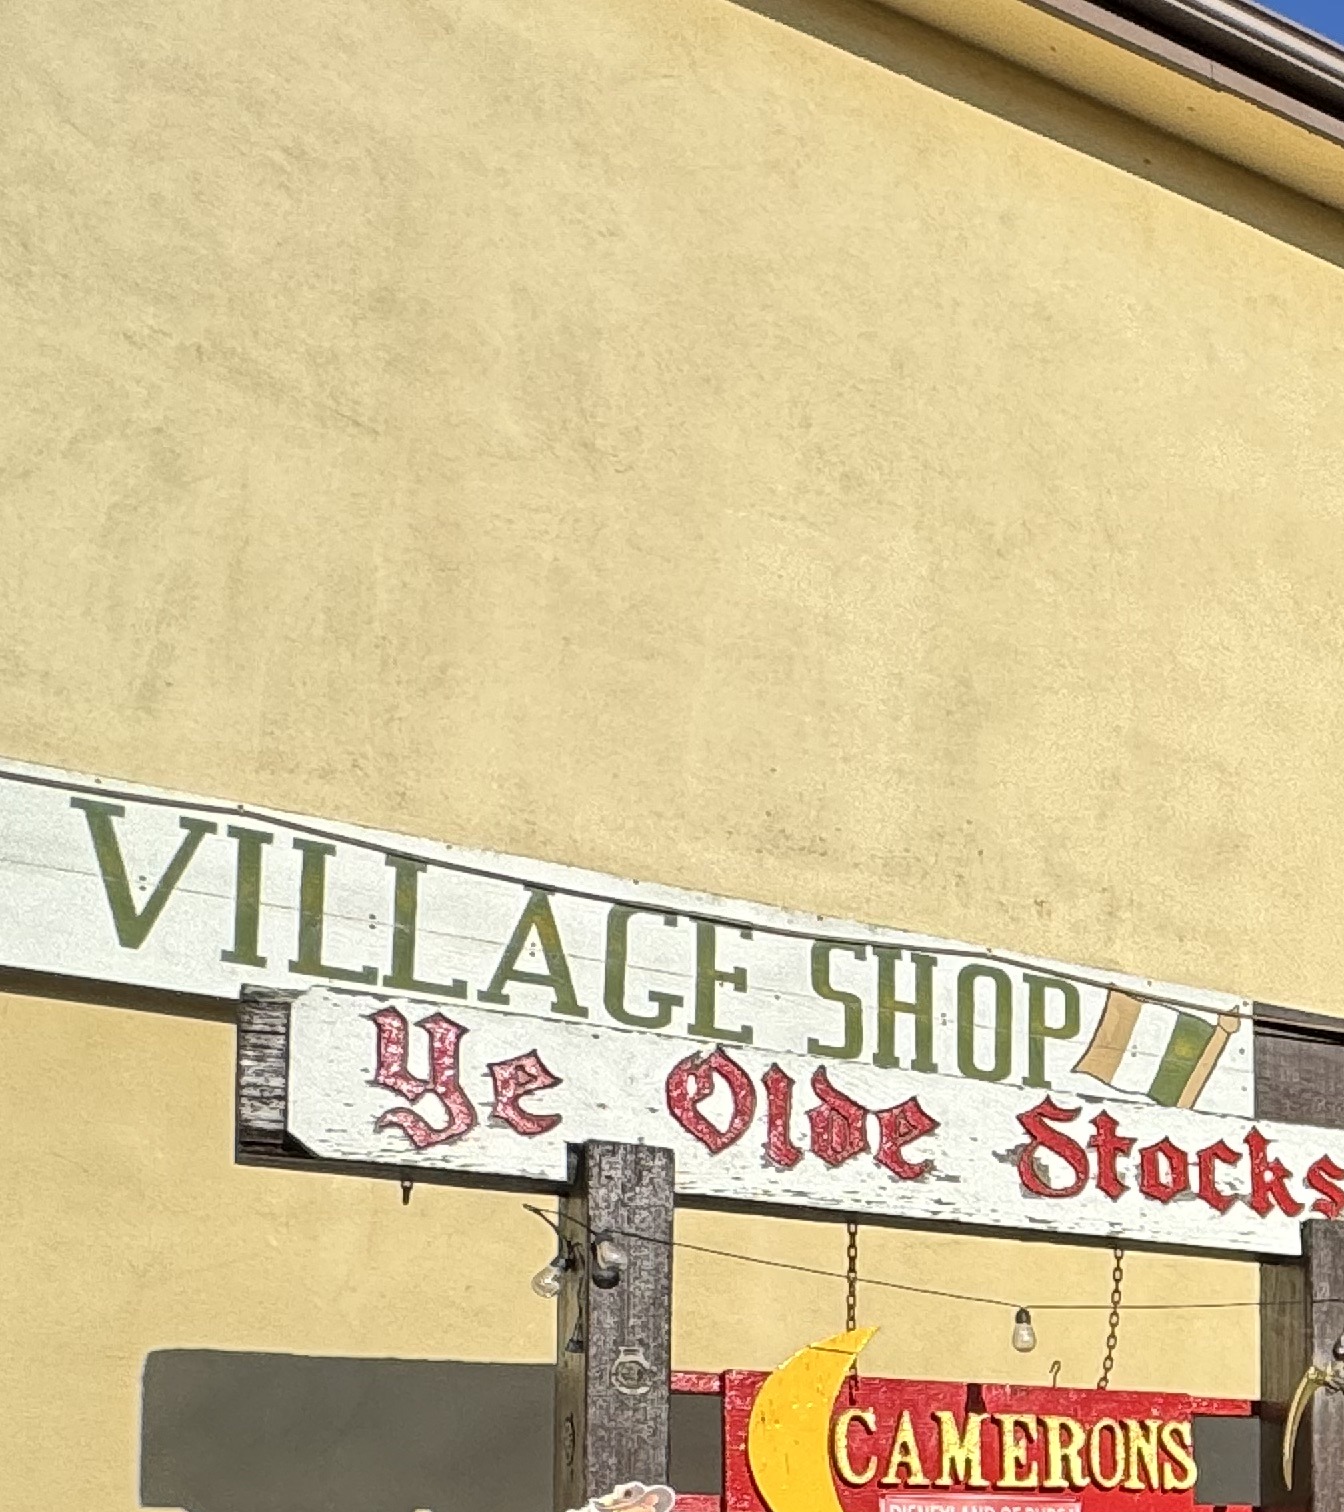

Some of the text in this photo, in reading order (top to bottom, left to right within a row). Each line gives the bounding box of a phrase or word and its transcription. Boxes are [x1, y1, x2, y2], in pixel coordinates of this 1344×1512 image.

[71, 795, 1080, 1090] VILLAGE SHOP
[369, 1006, 563, 1150] Ye
[666, 1044, 940, 1181] Olde
[833, 1408, 1199, 1491] CAMERONS
